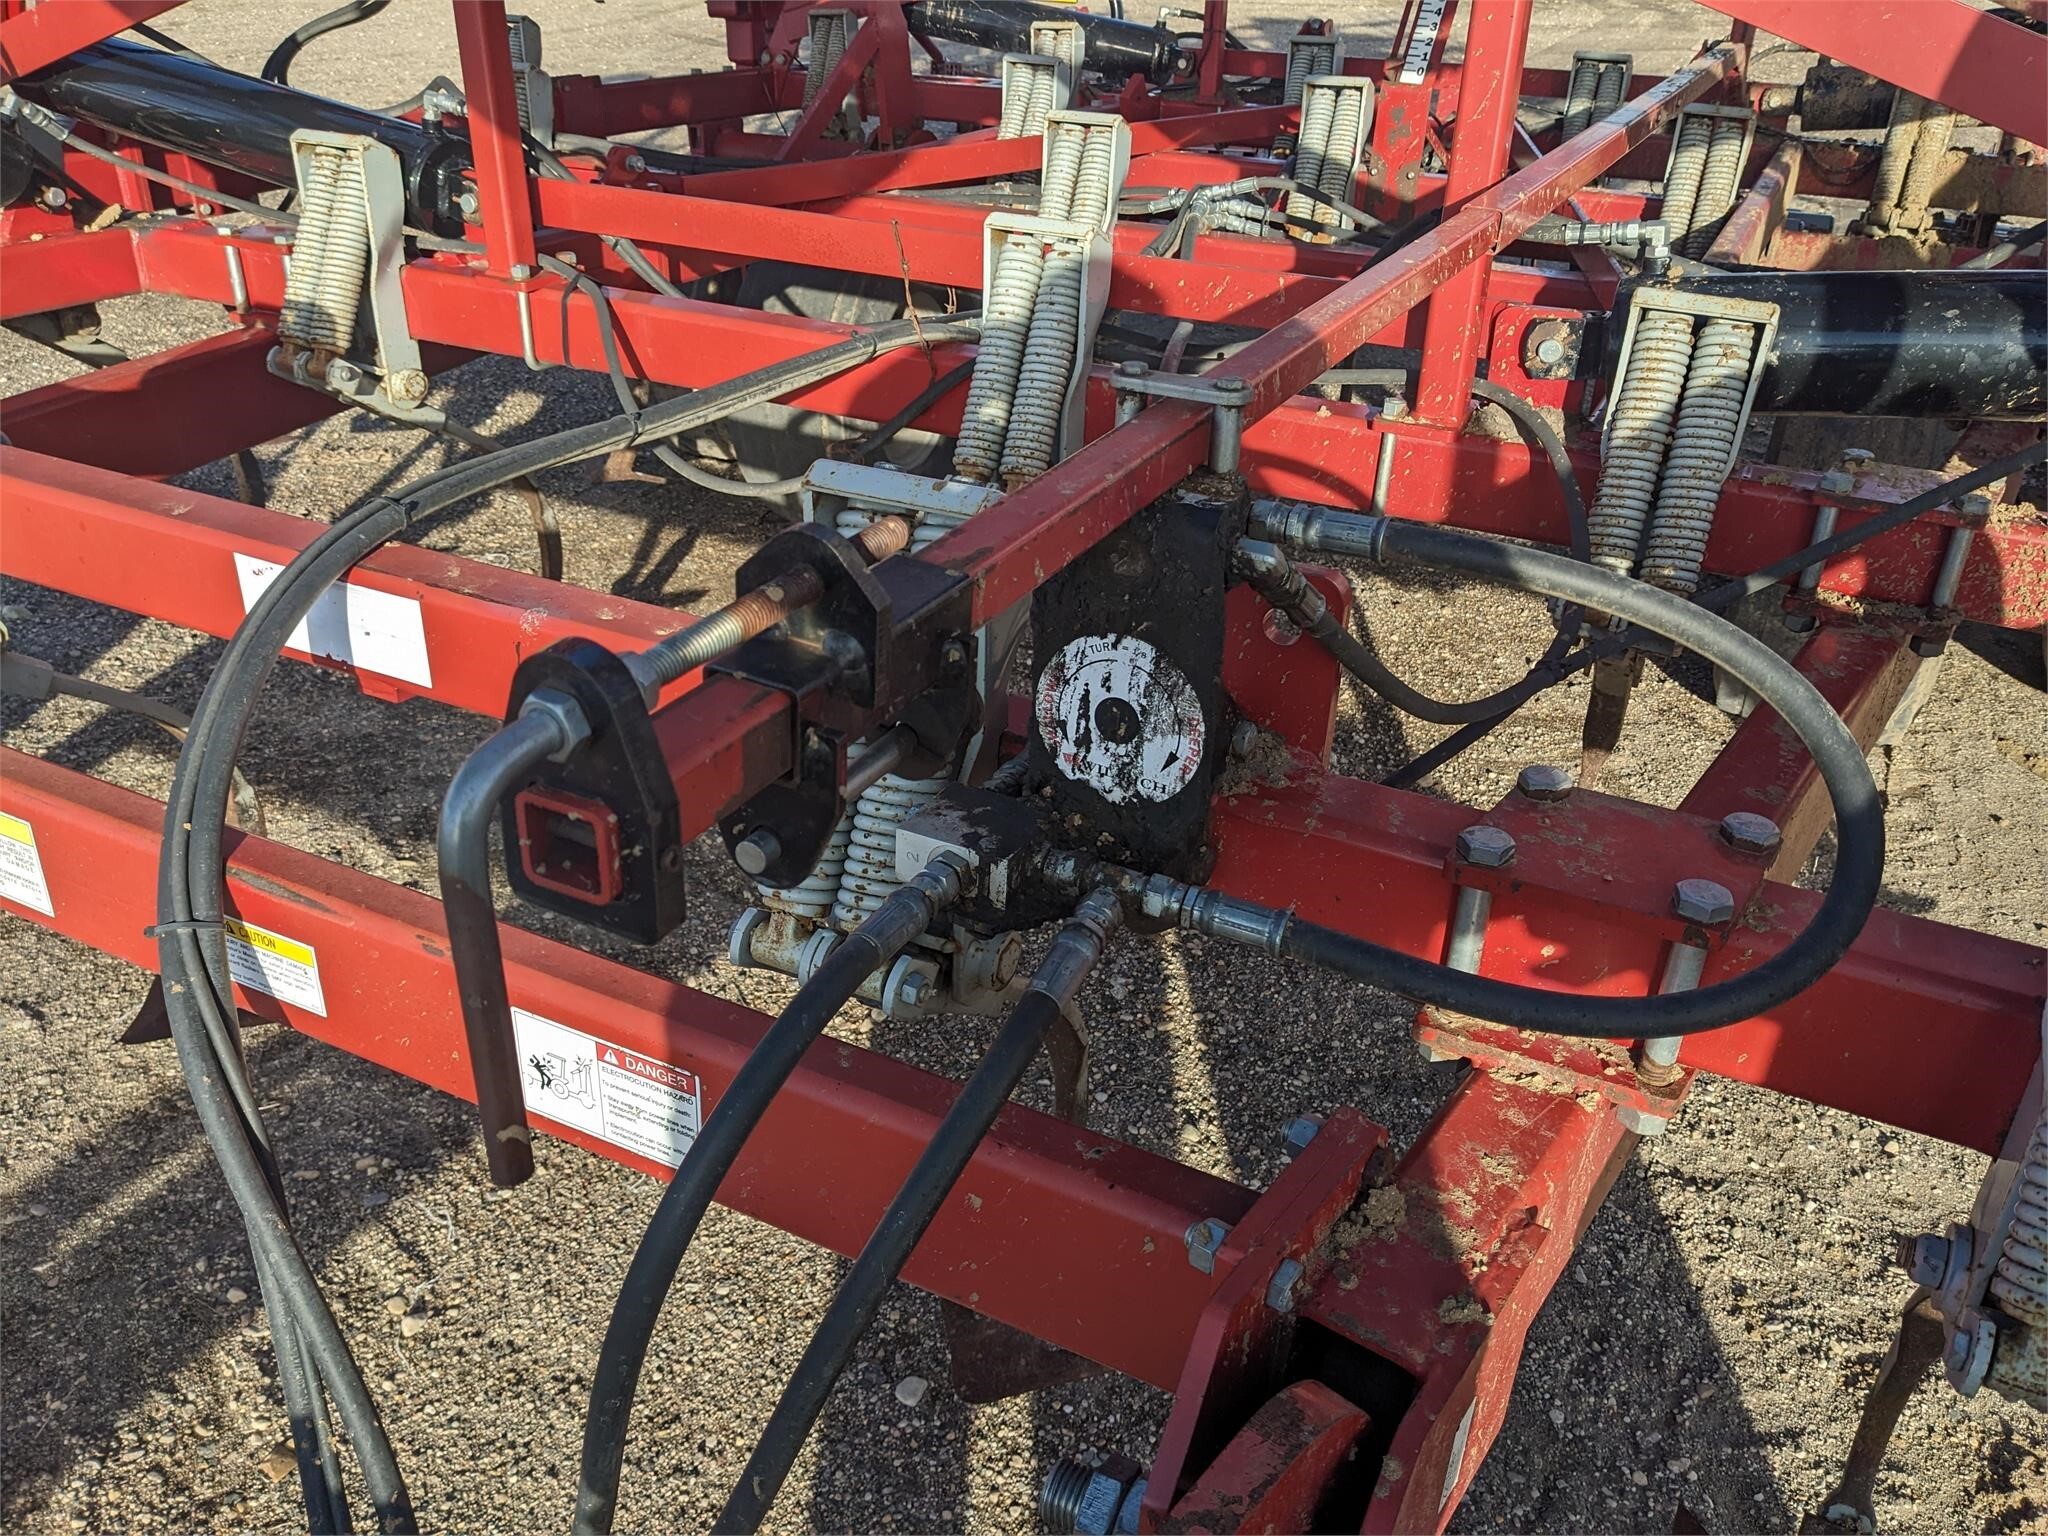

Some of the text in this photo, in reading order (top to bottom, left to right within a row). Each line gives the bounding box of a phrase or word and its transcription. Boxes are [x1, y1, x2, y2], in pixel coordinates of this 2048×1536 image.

[1434, 8, 1442, 17] 4
[1430, 22, 1438, 31] 3
[1424, 37, 1434, 46] 2
[1421, 52, 1428, 61] 1
[1416, 67, 1425, 76] 0
[907, 852, 920, 863] 2
[238, 927, 277, 950] CAUTION
[625, 1057, 688, 1090] DANGER
[601, 1065, 694, 1105] ELECTROCUTION HAZARD
[609, 1082, 629, 1094] prevent
[631, 1091, 650, 1102] serious
[651, 1098, 666, 1109] injury
[609, 1122, 645, 1139] Electrocution
[680, 1123, 695, 1133] when
